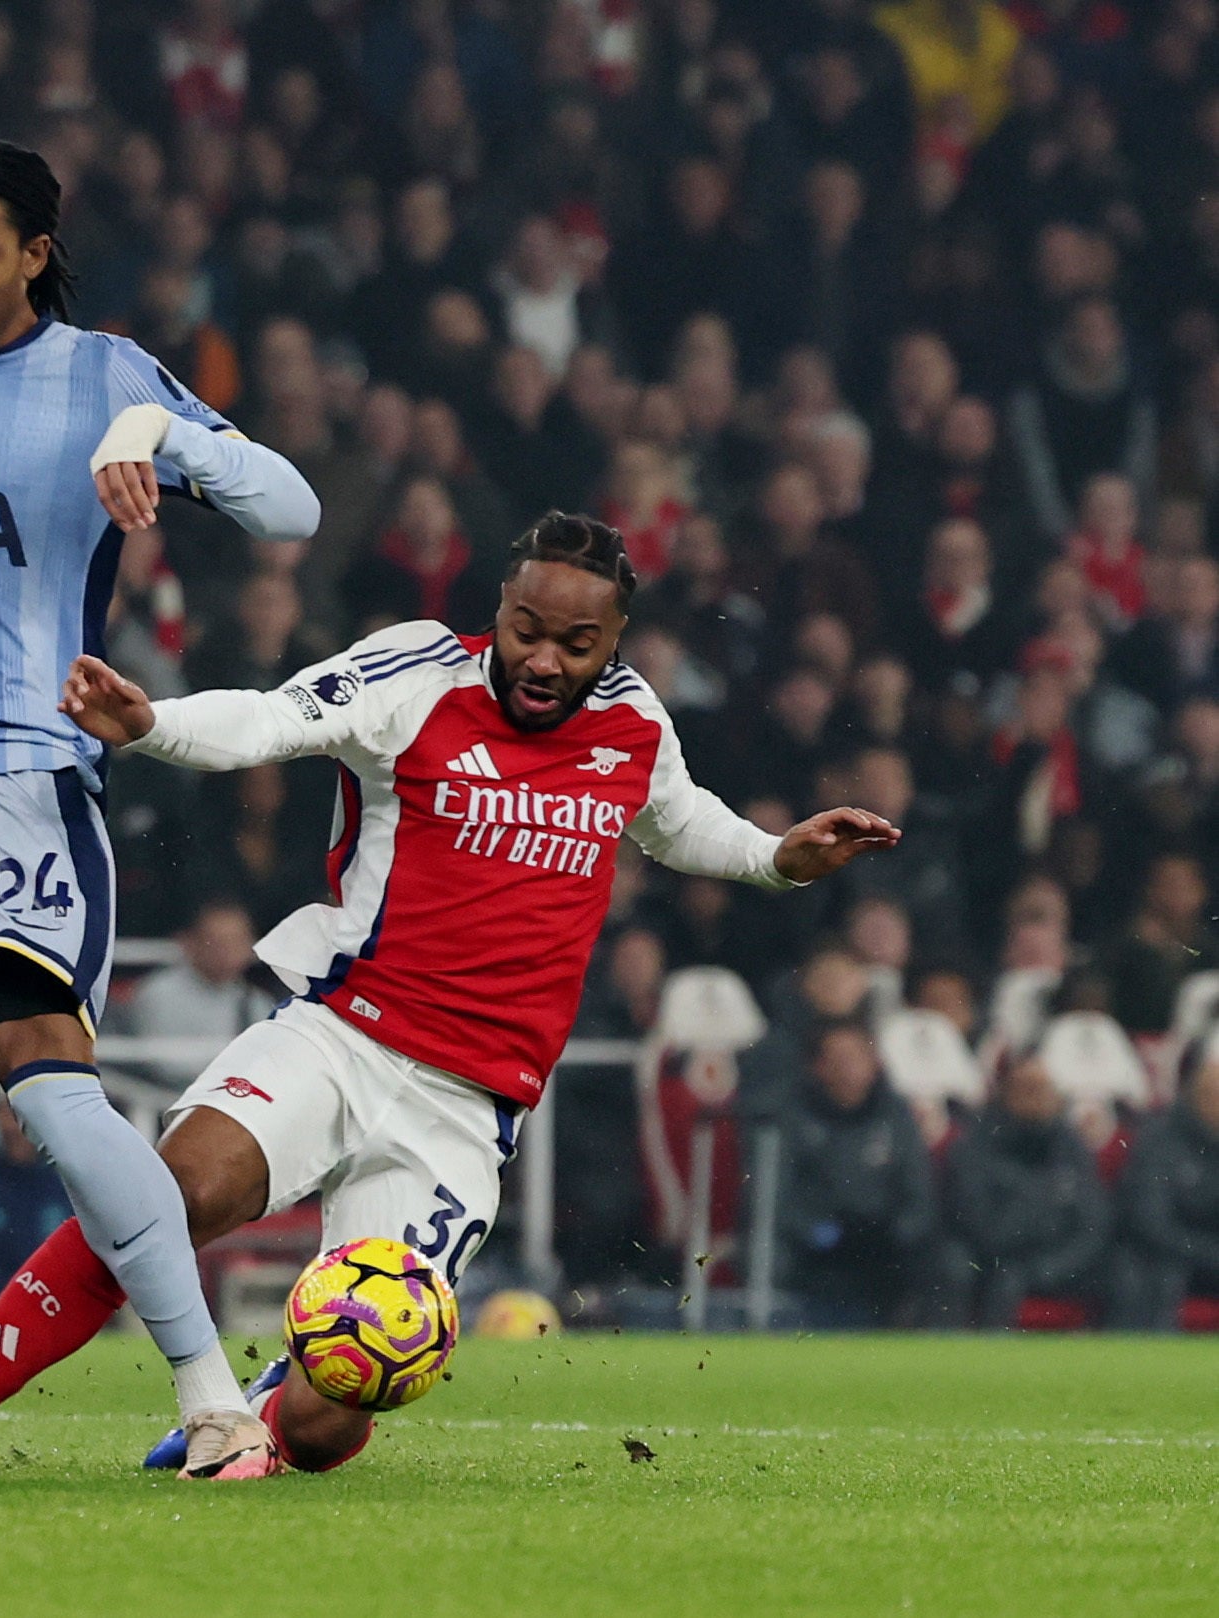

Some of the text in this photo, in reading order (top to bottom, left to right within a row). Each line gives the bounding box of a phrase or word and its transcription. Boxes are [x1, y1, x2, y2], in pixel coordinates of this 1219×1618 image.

[434, 780, 626, 838] Emirates
[453, 821, 601, 878] FLY BETTER
[16, 1271, 61, 1317] AFC
